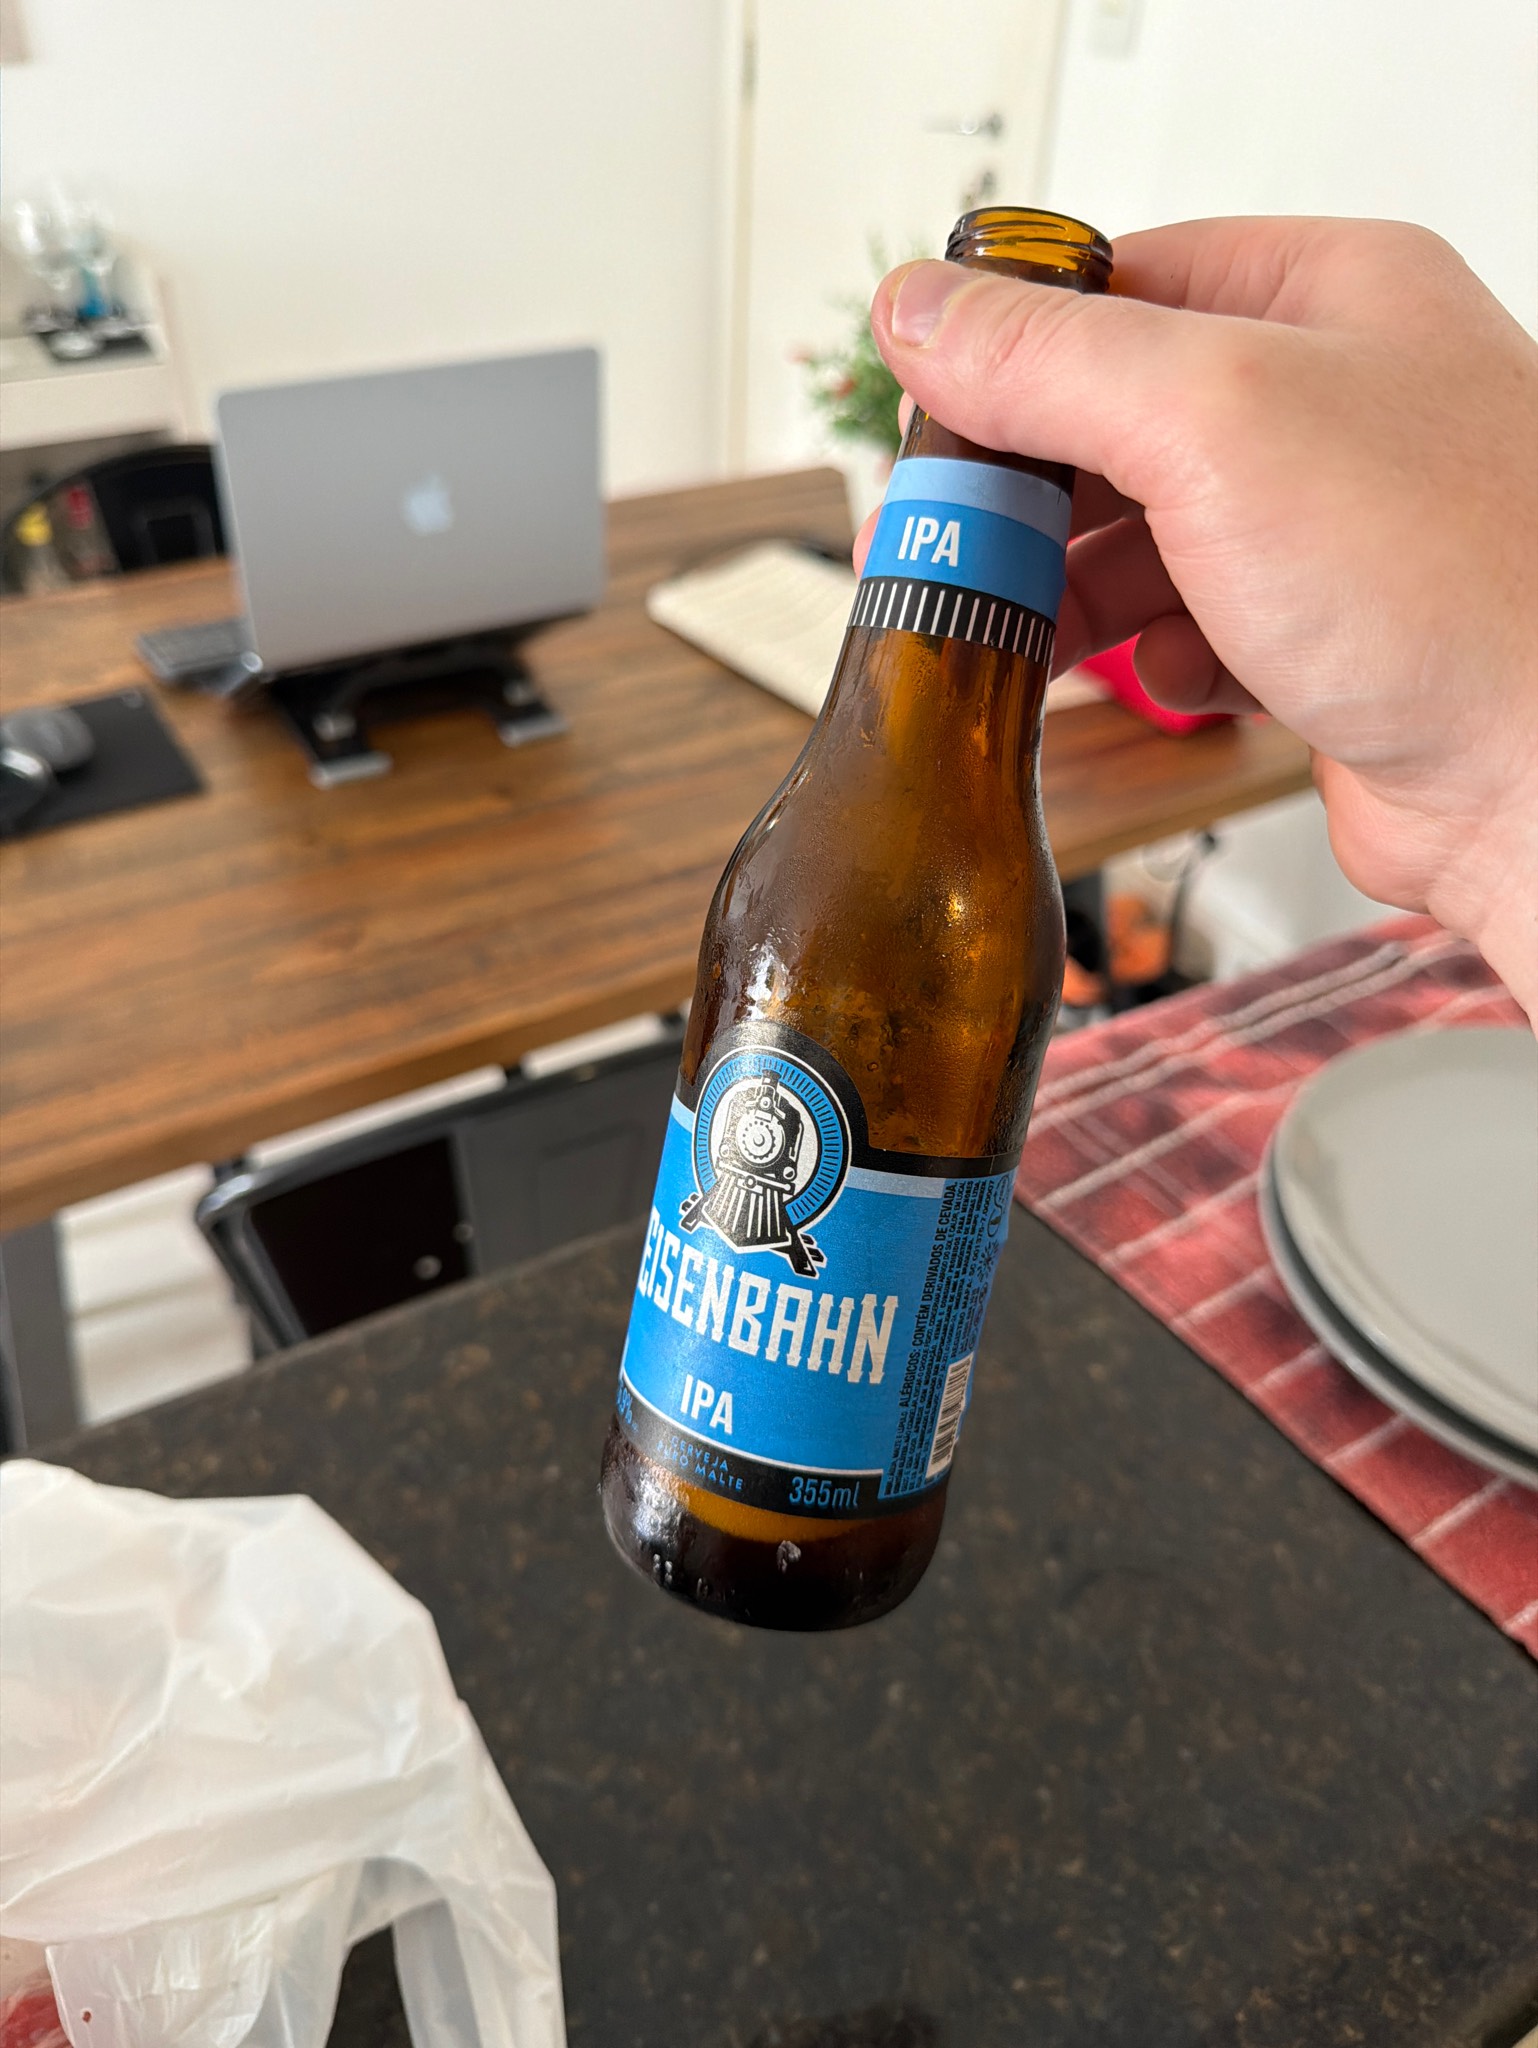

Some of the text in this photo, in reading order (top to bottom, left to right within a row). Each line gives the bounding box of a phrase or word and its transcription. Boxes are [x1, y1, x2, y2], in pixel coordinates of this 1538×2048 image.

[898, 516, 960, 567] IPA
[938, 1182, 957, 1225] CEVADA.
[934, 1228, 947, 1241] DE
[638, 1206, 898, 1384] EISENBAHN
[921, 1244, 944, 1302] DERIVADOS
[912, 1305, 931, 1346] CONTÉM
[899, 1349, 921, 1407] ALÉRGICOS:
[680, 1374, 733, 1435] IPA
[656, 1439, 744, 1490] PURO MALTE
[671, 1435, 729, 1471] CERVEJA
[788, 1476, 860, 1510] 355ml
